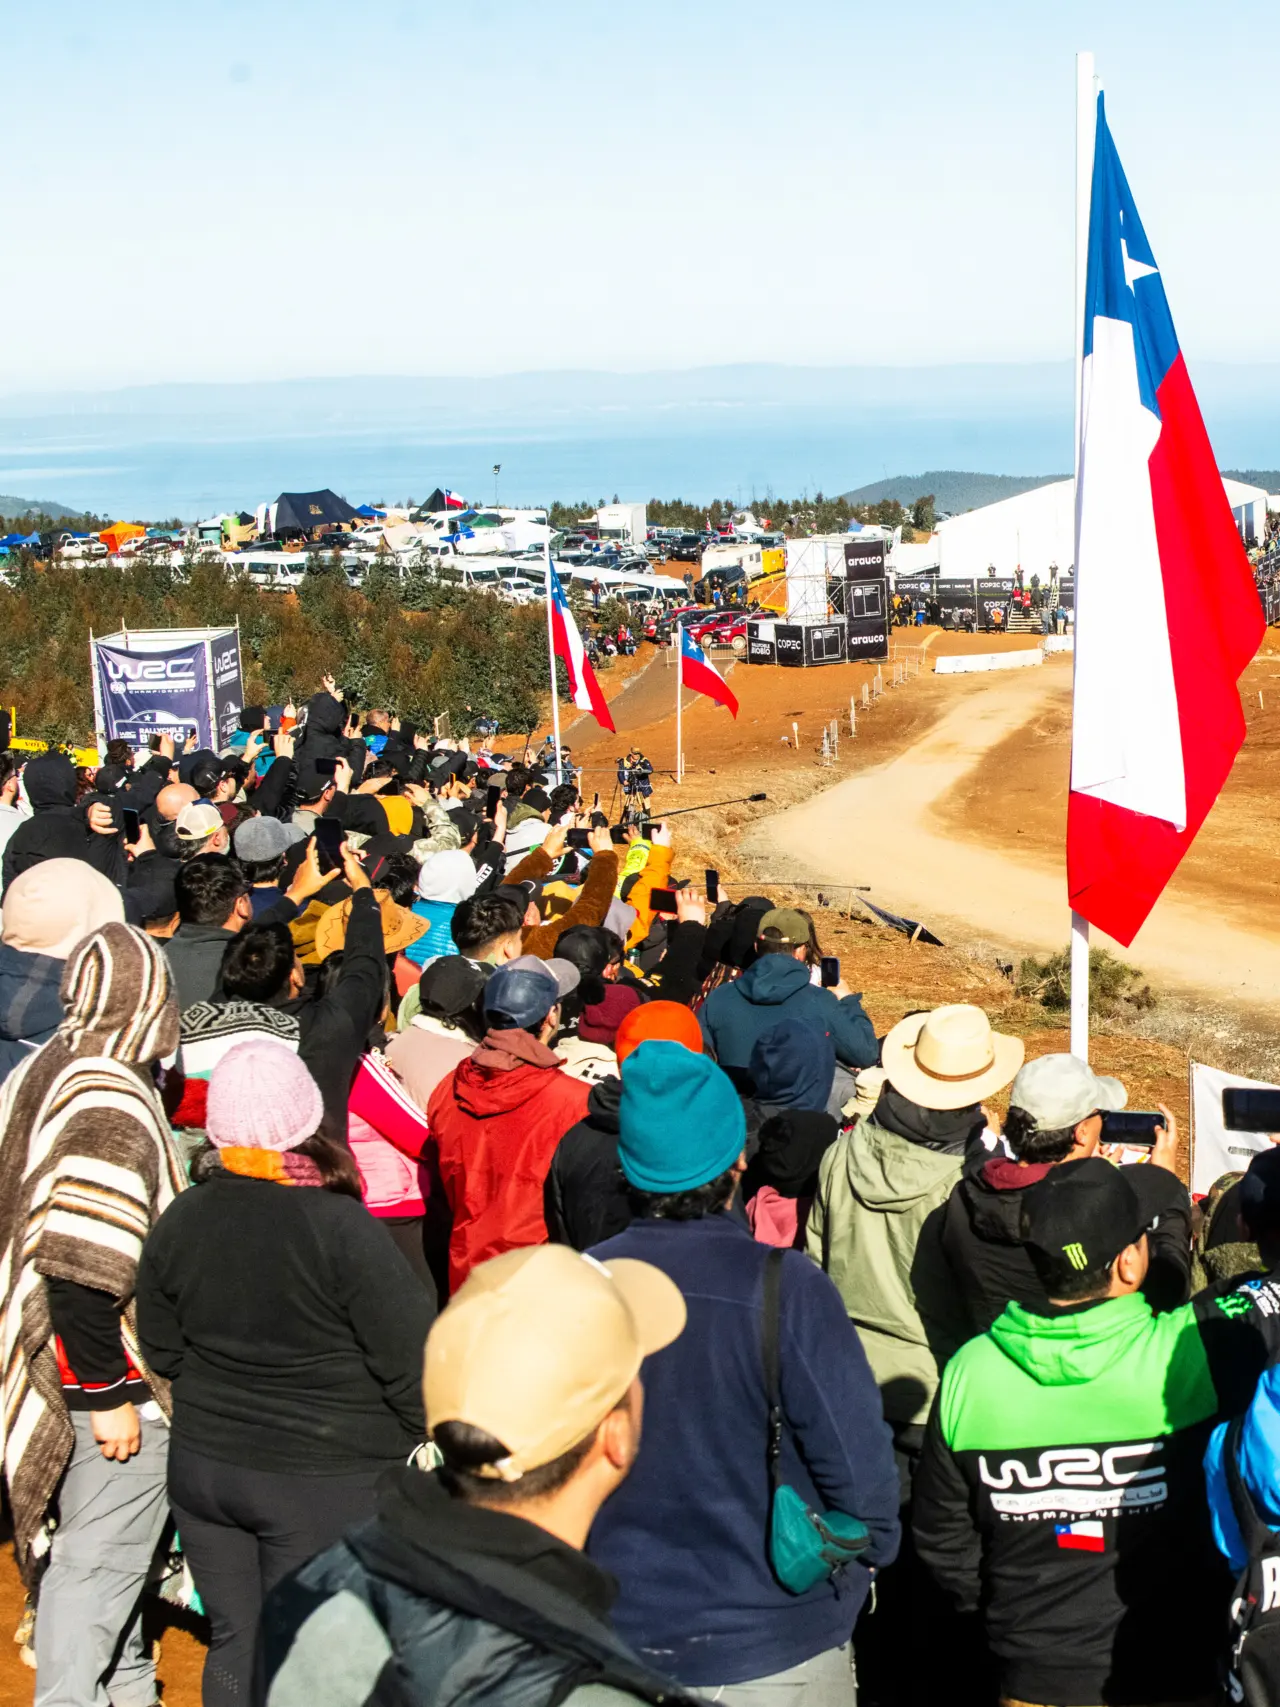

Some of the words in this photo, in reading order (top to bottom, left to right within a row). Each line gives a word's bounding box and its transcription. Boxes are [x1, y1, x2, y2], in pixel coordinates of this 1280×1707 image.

[848, 555, 882, 567] arauco
[777, 639, 801, 650] COPEC
[851, 634, 884, 645] arauco
[108, 658, 195, 680] WRC
[139, 726, 184, 734] RALLYCHILE
[978, 1442, 1166, 1490] WRC
[1000, 1503, 1165, 1522] CHAMPIONSHIP
